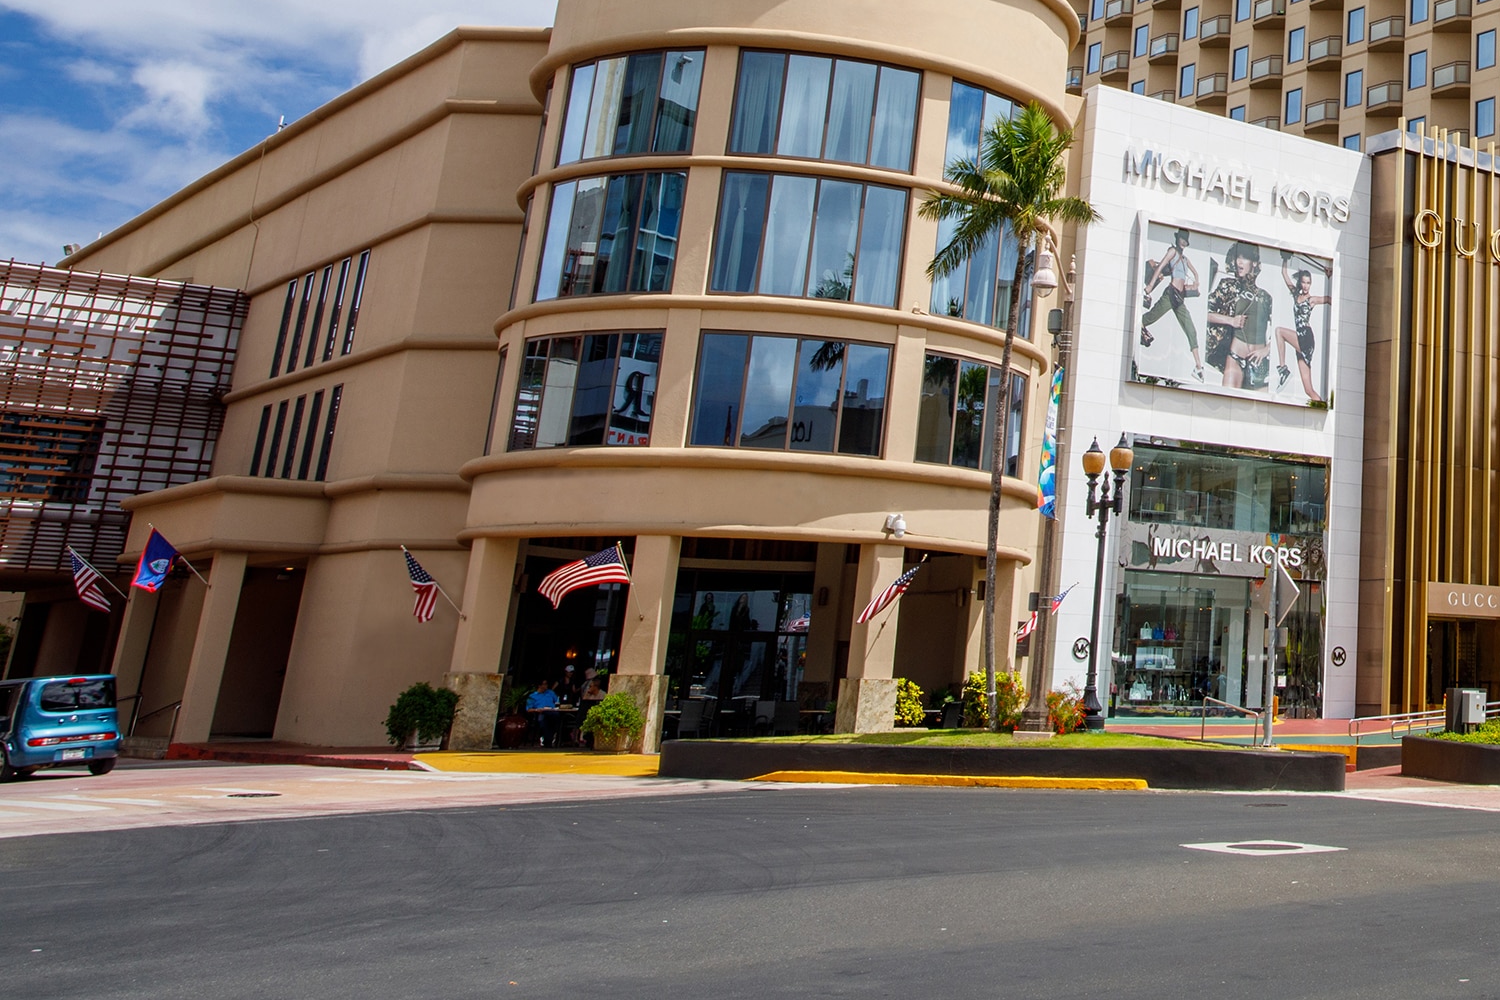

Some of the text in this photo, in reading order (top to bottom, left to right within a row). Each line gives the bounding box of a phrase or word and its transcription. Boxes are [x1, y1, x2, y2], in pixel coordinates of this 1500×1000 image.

[1123, 147, 1351, 223] MICHAEL KORS
[1153, 537, 1301, 567] MICHAEL KORS
